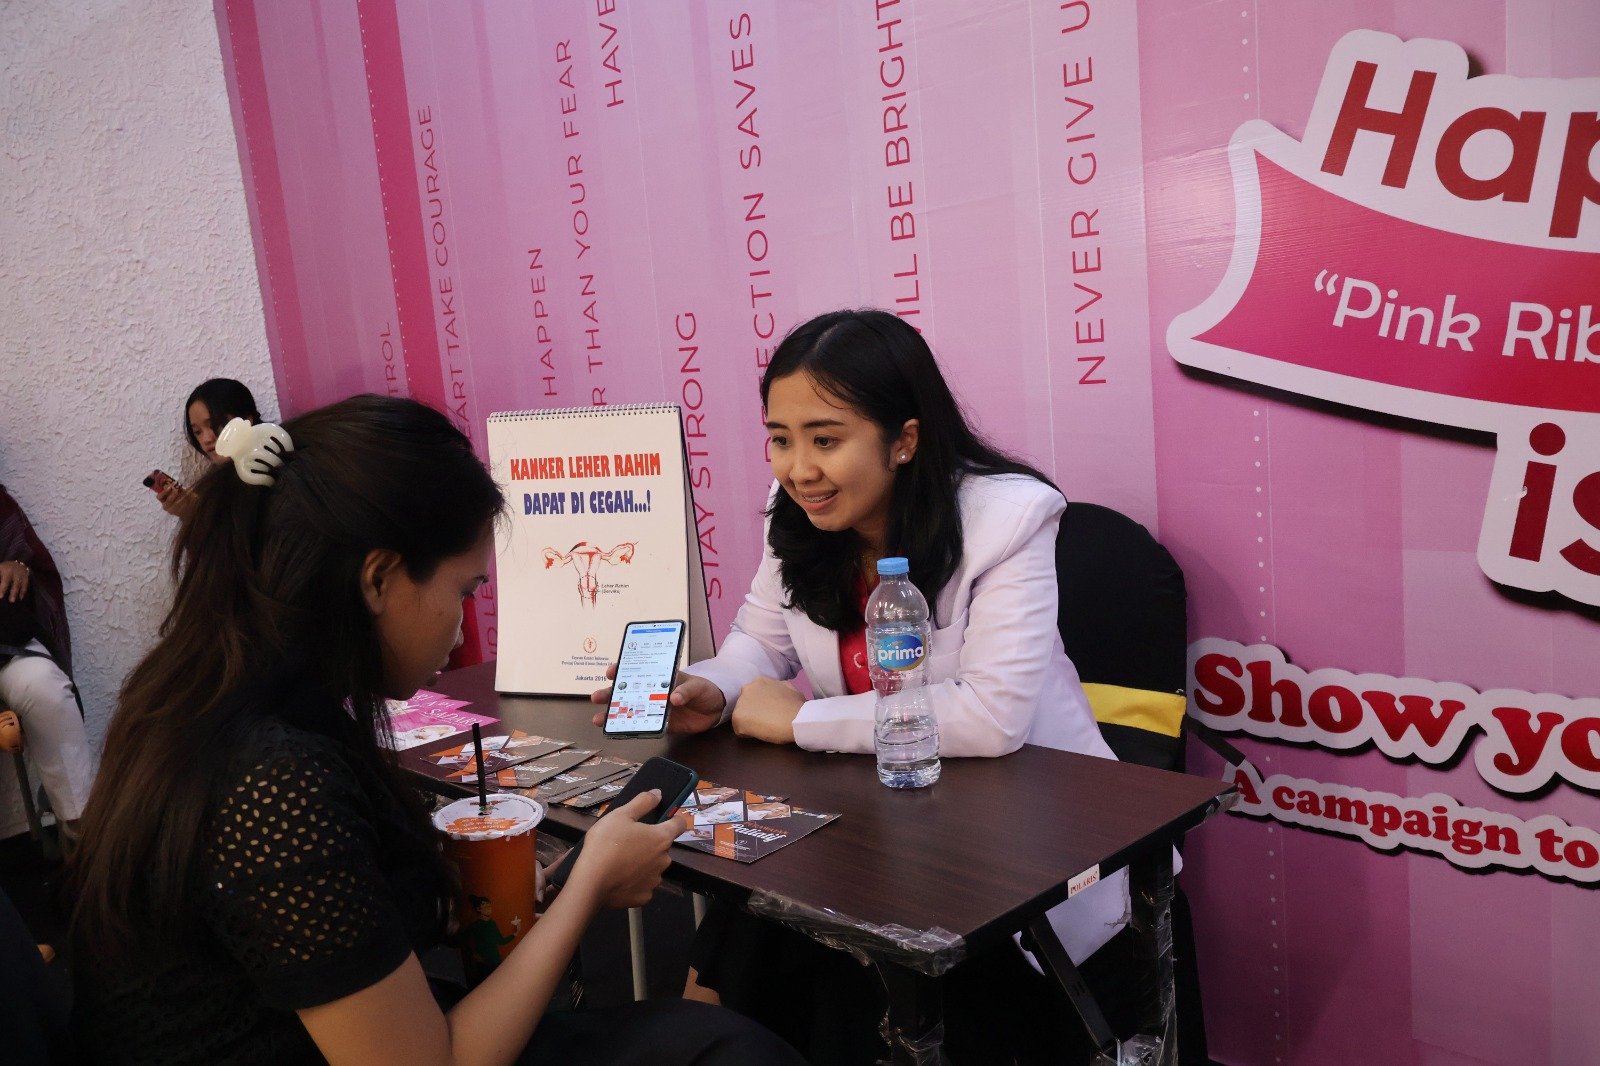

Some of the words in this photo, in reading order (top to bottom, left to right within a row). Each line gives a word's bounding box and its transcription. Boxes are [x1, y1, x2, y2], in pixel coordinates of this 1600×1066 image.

[556, 39, 579, 138] FEAR
[597, 0, 624, 107] HAVE
[730, 13, 761, 169] SAVES
[875, 0, 911, 168] BRIGHT
[1063, 57, 1097, 185] GIVE
[418, 105, 449, 267] COURAGE
[568, 153, 590, 260] YOUR
[888, 181, 915, 241] BE
[435, 277, 460, 356] TAKE
[528, 249, 557, 396] HAPPEN
[579, 274, 602, 373] THAN
[743, 193, 777, 462] ECTION
[893, 253, 921, 333] ILL
[1071, 208, 1106, 385] NEVER
[380, 322, 398, 398] TROL
[450, 364, 471, 438] ART
[675, 312, 711, 489] STRONG
[510, 457, 565, 480] KANKER
[568, 455, 611, 478] LEHER
[614, 453, 661, 476] RAHIM
[523, 492, 565, 515] DAPAT
[570, 492, 585, 514] DI
[878, 645, 924, 662] prima
[1194, 653, 1466, 747] Show
[1491, 706, 1600, 776] yo
[1233, 769, 1261, 804] A
[1272, 784, 1521, 856] campaign
[1534, 828, 1600, 868] to
